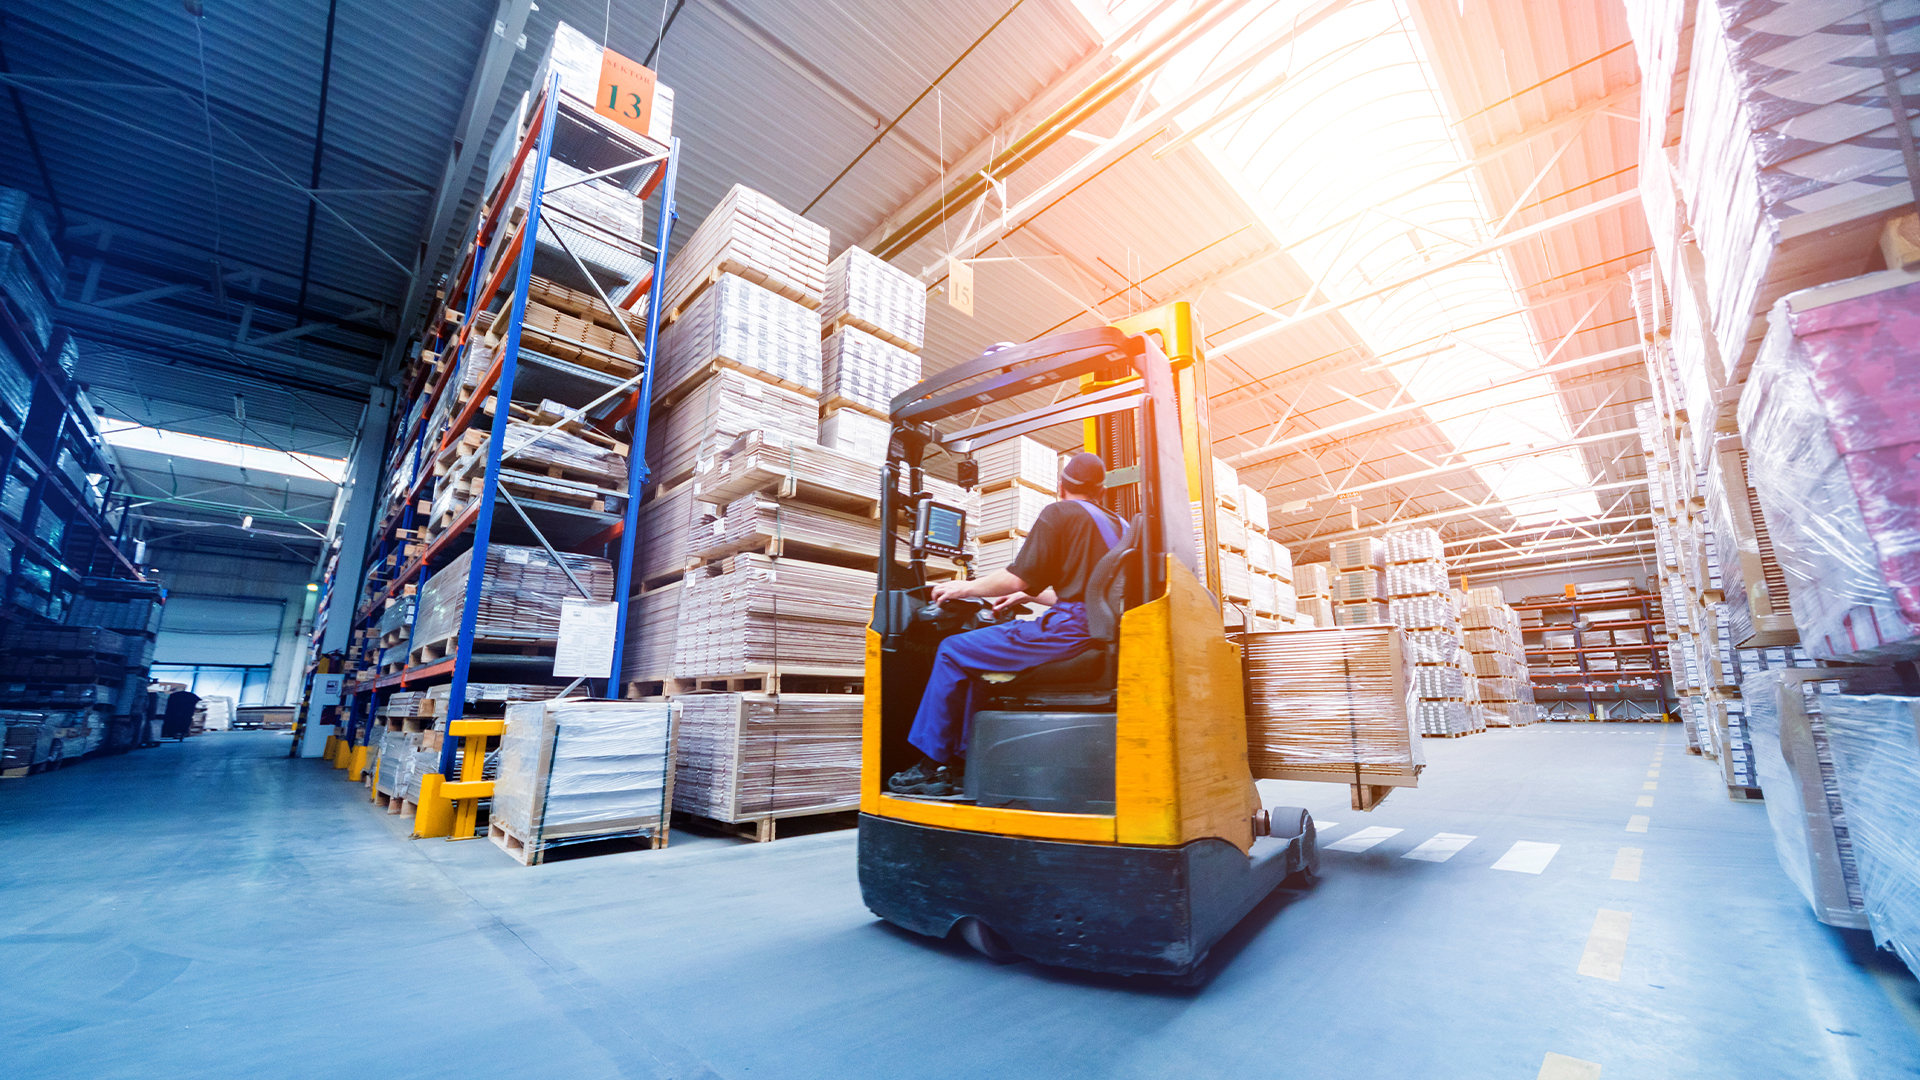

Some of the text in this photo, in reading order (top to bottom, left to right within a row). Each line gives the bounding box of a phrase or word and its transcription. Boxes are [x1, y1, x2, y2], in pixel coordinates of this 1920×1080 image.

[608, 60, 650, 84] SEKTOR
[605, 84, 642, 119] 13
[955, 282, 970, 305] 15
